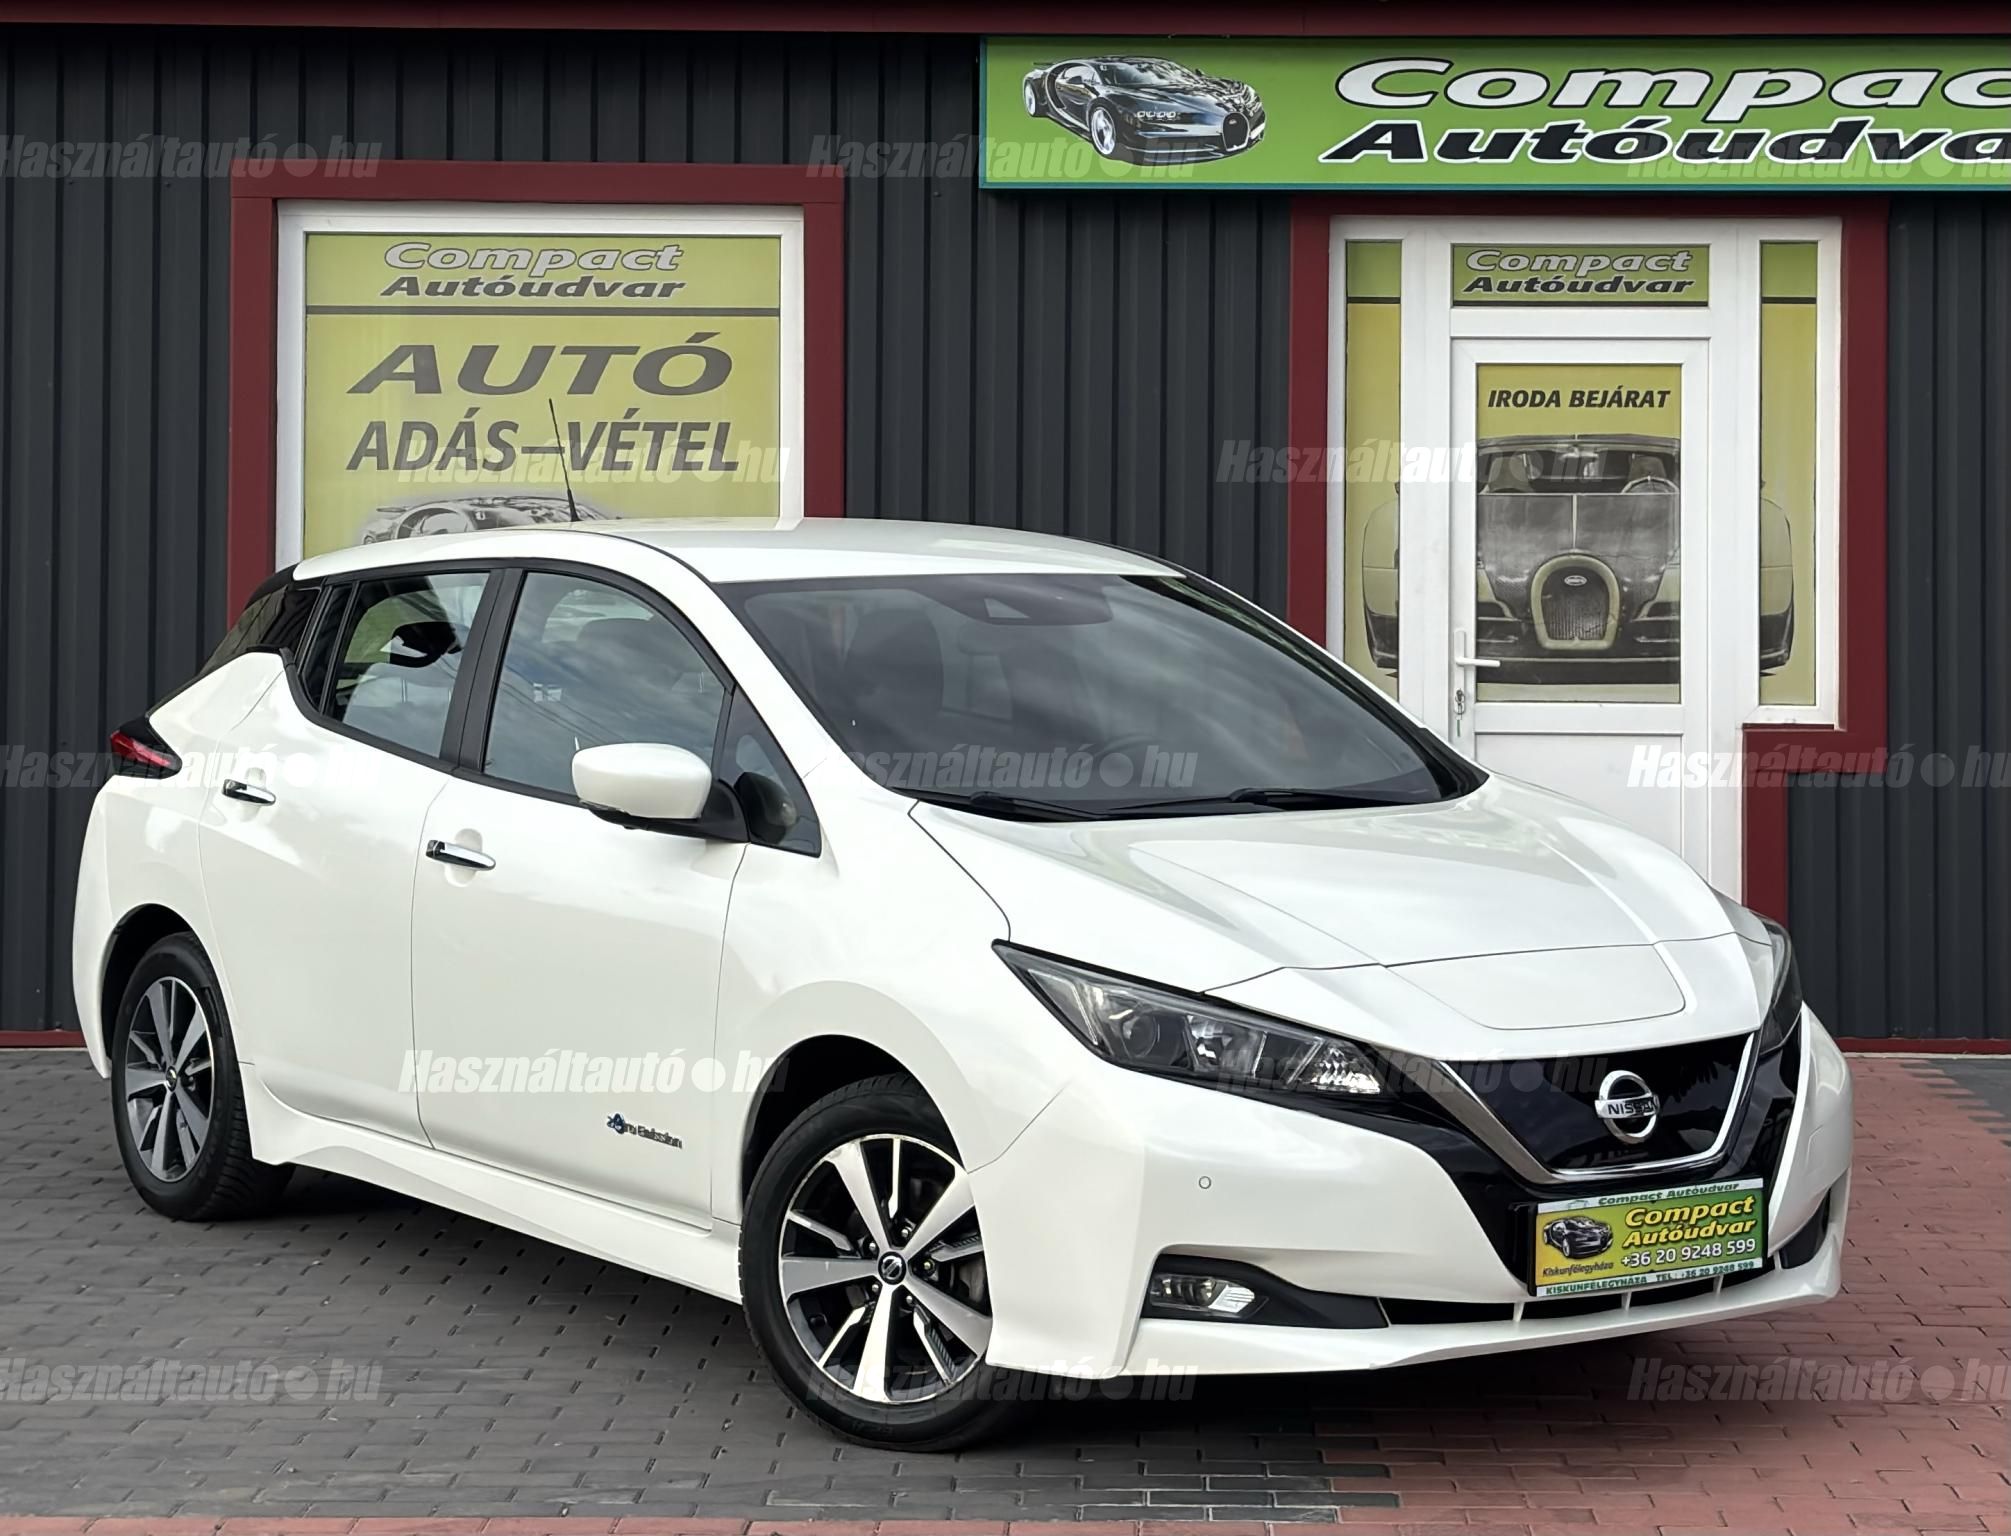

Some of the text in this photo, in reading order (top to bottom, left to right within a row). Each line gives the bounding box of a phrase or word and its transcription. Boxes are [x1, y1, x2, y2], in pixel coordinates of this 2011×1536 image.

[384, 242, 684, 278] Compact
[1466, 249, 1693, 278] Compact
[380, 274, 687, 299] Autóudvar
[1462, 275, 1695, 294] Autóudvar
[346, 332, 733, 396] AUTÓ
[1488, 385, 1671, 408] IRODA BEJÁRAT
[1607, 1099, 1657, 1115] NISSAN
[1598, 1182, 1740, 1206] Compact Autóudvar
[1625, 1195, 1755, 1227] Compact
[1622, 1219, 1757, 1249] Autóudvar
[1621, 1238, 1756, 1268] +36 20 9248 599
